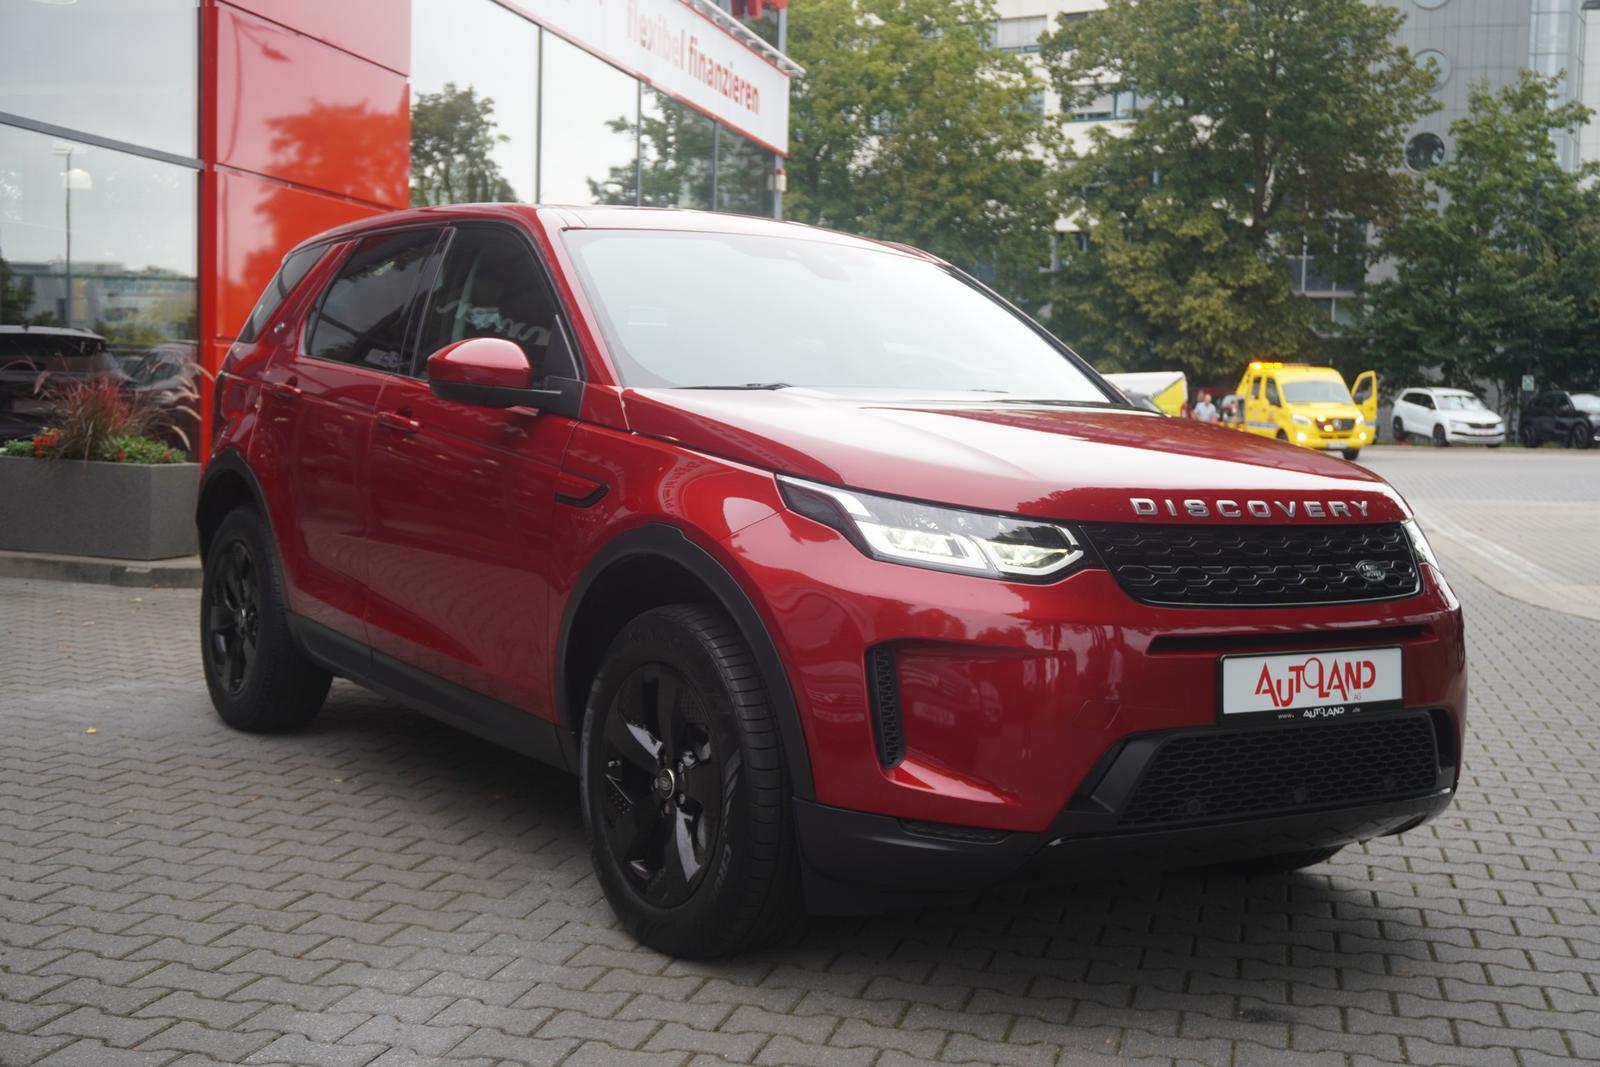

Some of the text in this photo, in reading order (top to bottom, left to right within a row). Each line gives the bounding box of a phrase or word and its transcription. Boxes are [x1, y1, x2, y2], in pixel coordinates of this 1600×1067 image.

[627, 0, 760, 115] flexibel finanzieren
[1129, 497, 1369, 518] DISCOVERY
[1255, 657, 1376, 707] AUTOLAND
